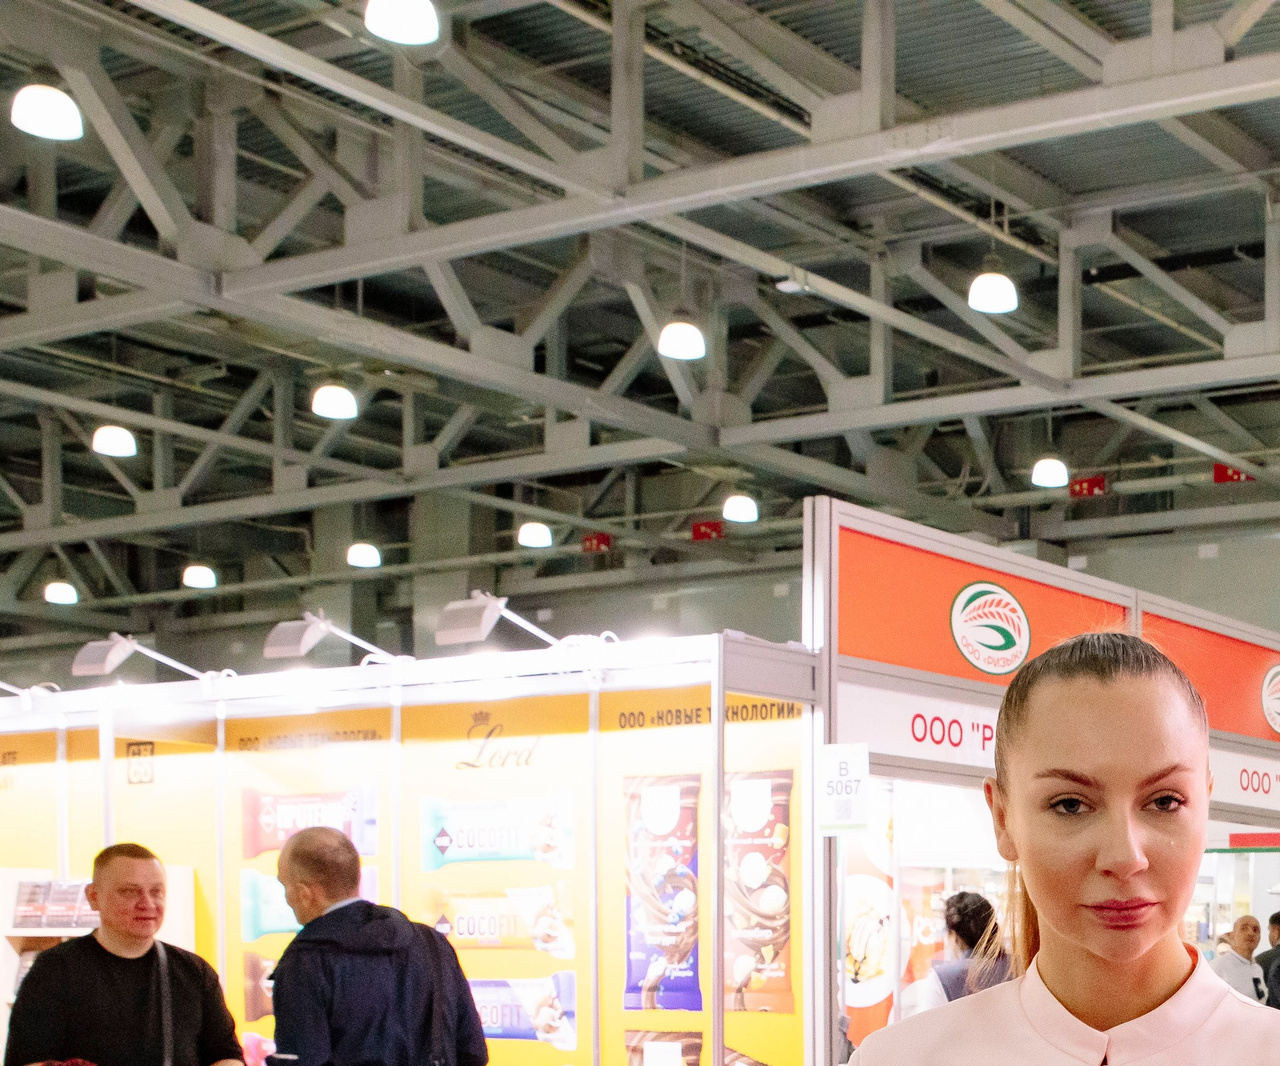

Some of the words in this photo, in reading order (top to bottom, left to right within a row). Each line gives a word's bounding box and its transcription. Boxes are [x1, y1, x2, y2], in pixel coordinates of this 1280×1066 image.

[618, 711, 646, 729] ООО
[911, 713, 963, 748] ООО
[838, 761, 849, 777] B
[826, 779, 861, 797] 5067
[1239, 768, 1271, 794] ООО
[456, 916, 520, 936] COCOFIT
